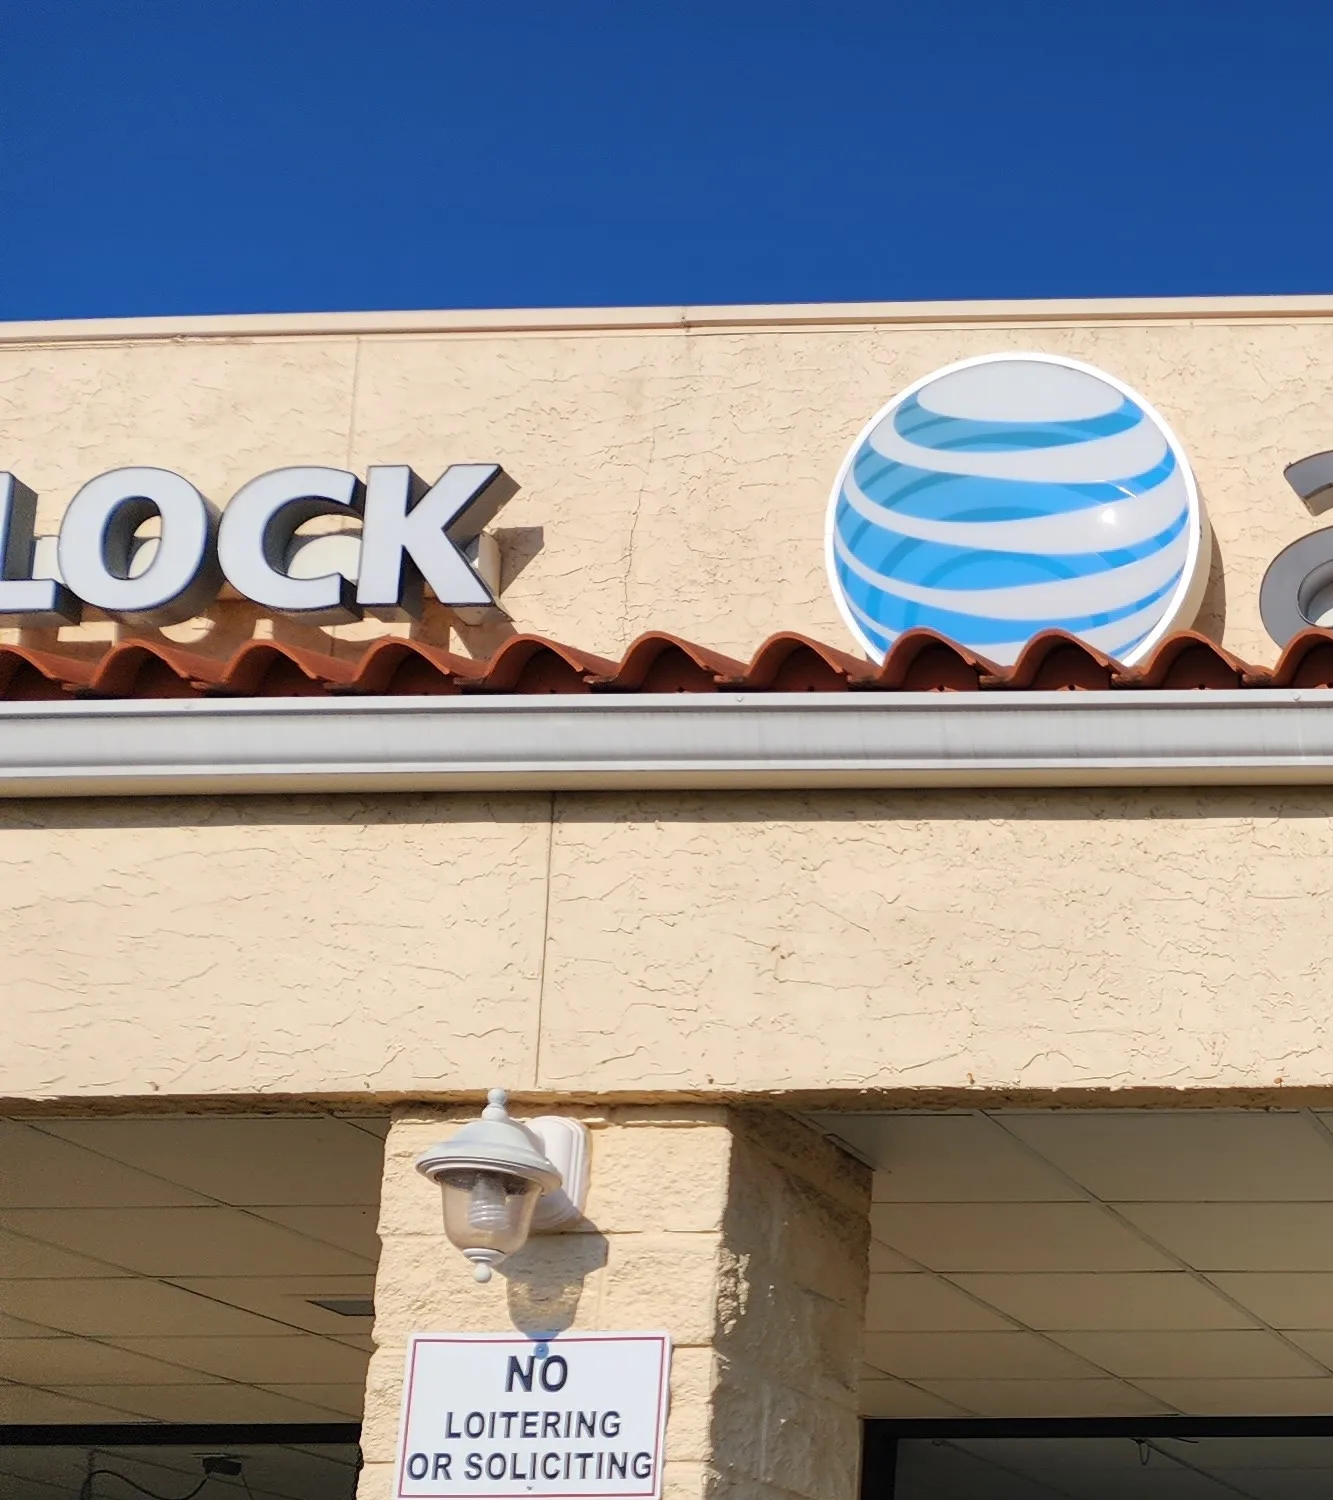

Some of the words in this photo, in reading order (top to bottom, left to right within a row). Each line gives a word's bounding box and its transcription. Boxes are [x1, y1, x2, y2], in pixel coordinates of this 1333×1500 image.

[505, 1355, 568, 1393] NO
[445, 1410, 622, 1439] LOITERING
[406, 1453, 452, 1481] OR
[463, 1452, 653, 1480] SOLICITING
